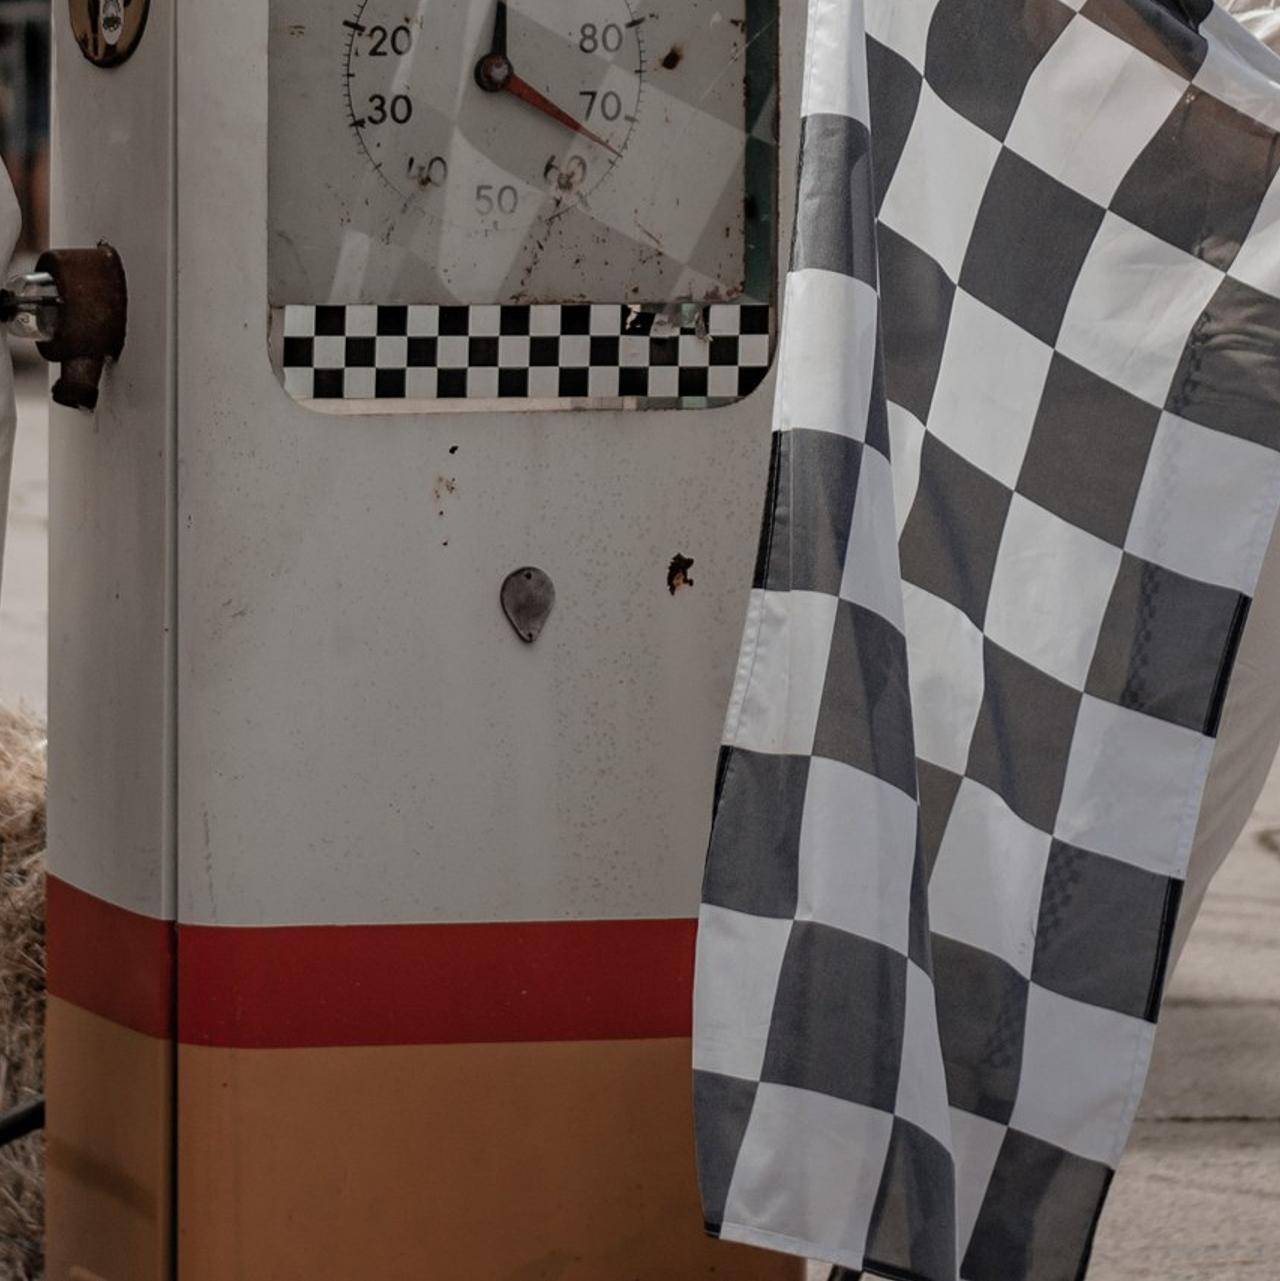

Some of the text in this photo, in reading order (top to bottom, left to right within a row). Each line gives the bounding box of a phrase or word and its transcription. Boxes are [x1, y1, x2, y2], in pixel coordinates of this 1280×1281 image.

[369, 25, 412, 56] 20
[579, 23, 623, 53] 80
[368, 94, 412, 124] 30
[579, 91, 622, 121] 70
[475, 185, 518, 215] 50
